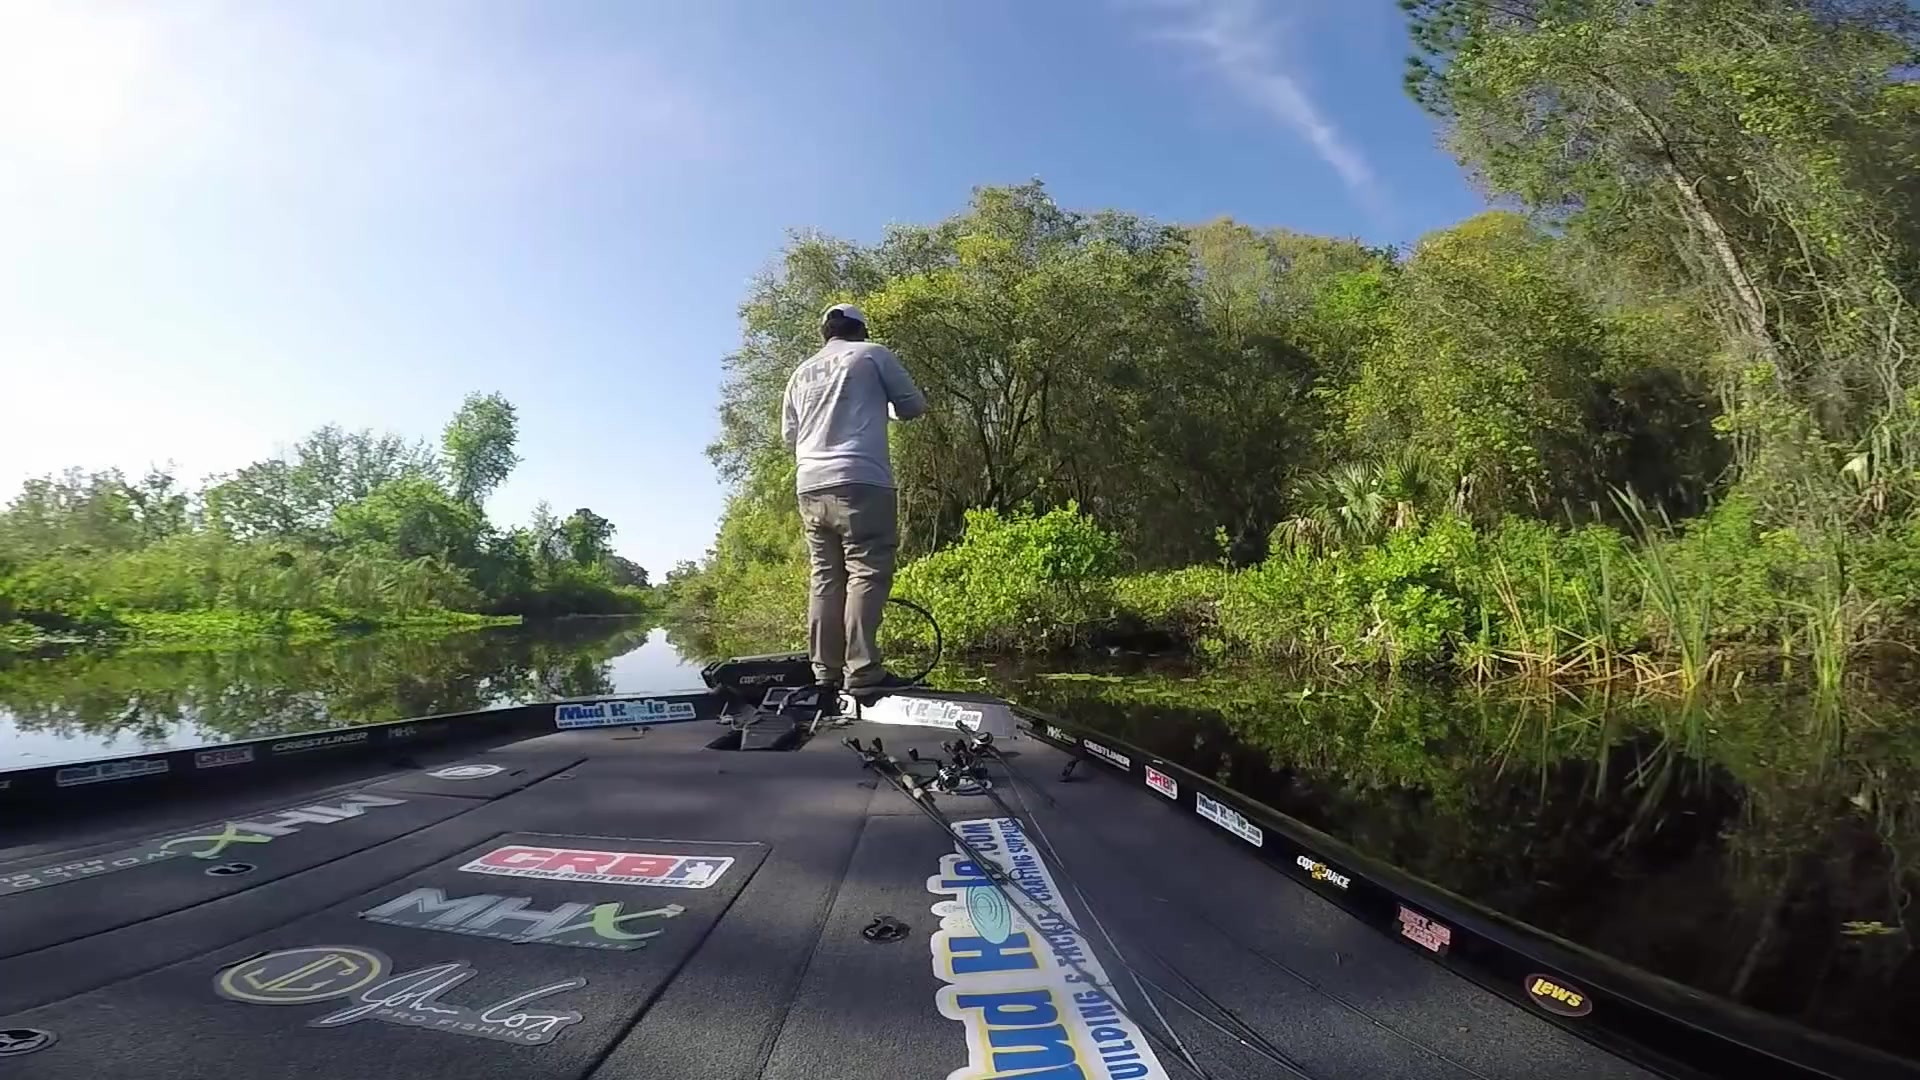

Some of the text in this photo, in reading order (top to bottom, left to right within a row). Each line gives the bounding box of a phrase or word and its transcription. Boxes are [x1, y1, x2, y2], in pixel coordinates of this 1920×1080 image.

[558, 706, 605, 721] Mud
[272, 731, 369, 752] CRESTLINER
[479, 848, 681, 878] CRB
[434, 1018, 542, 1042] FISHING
